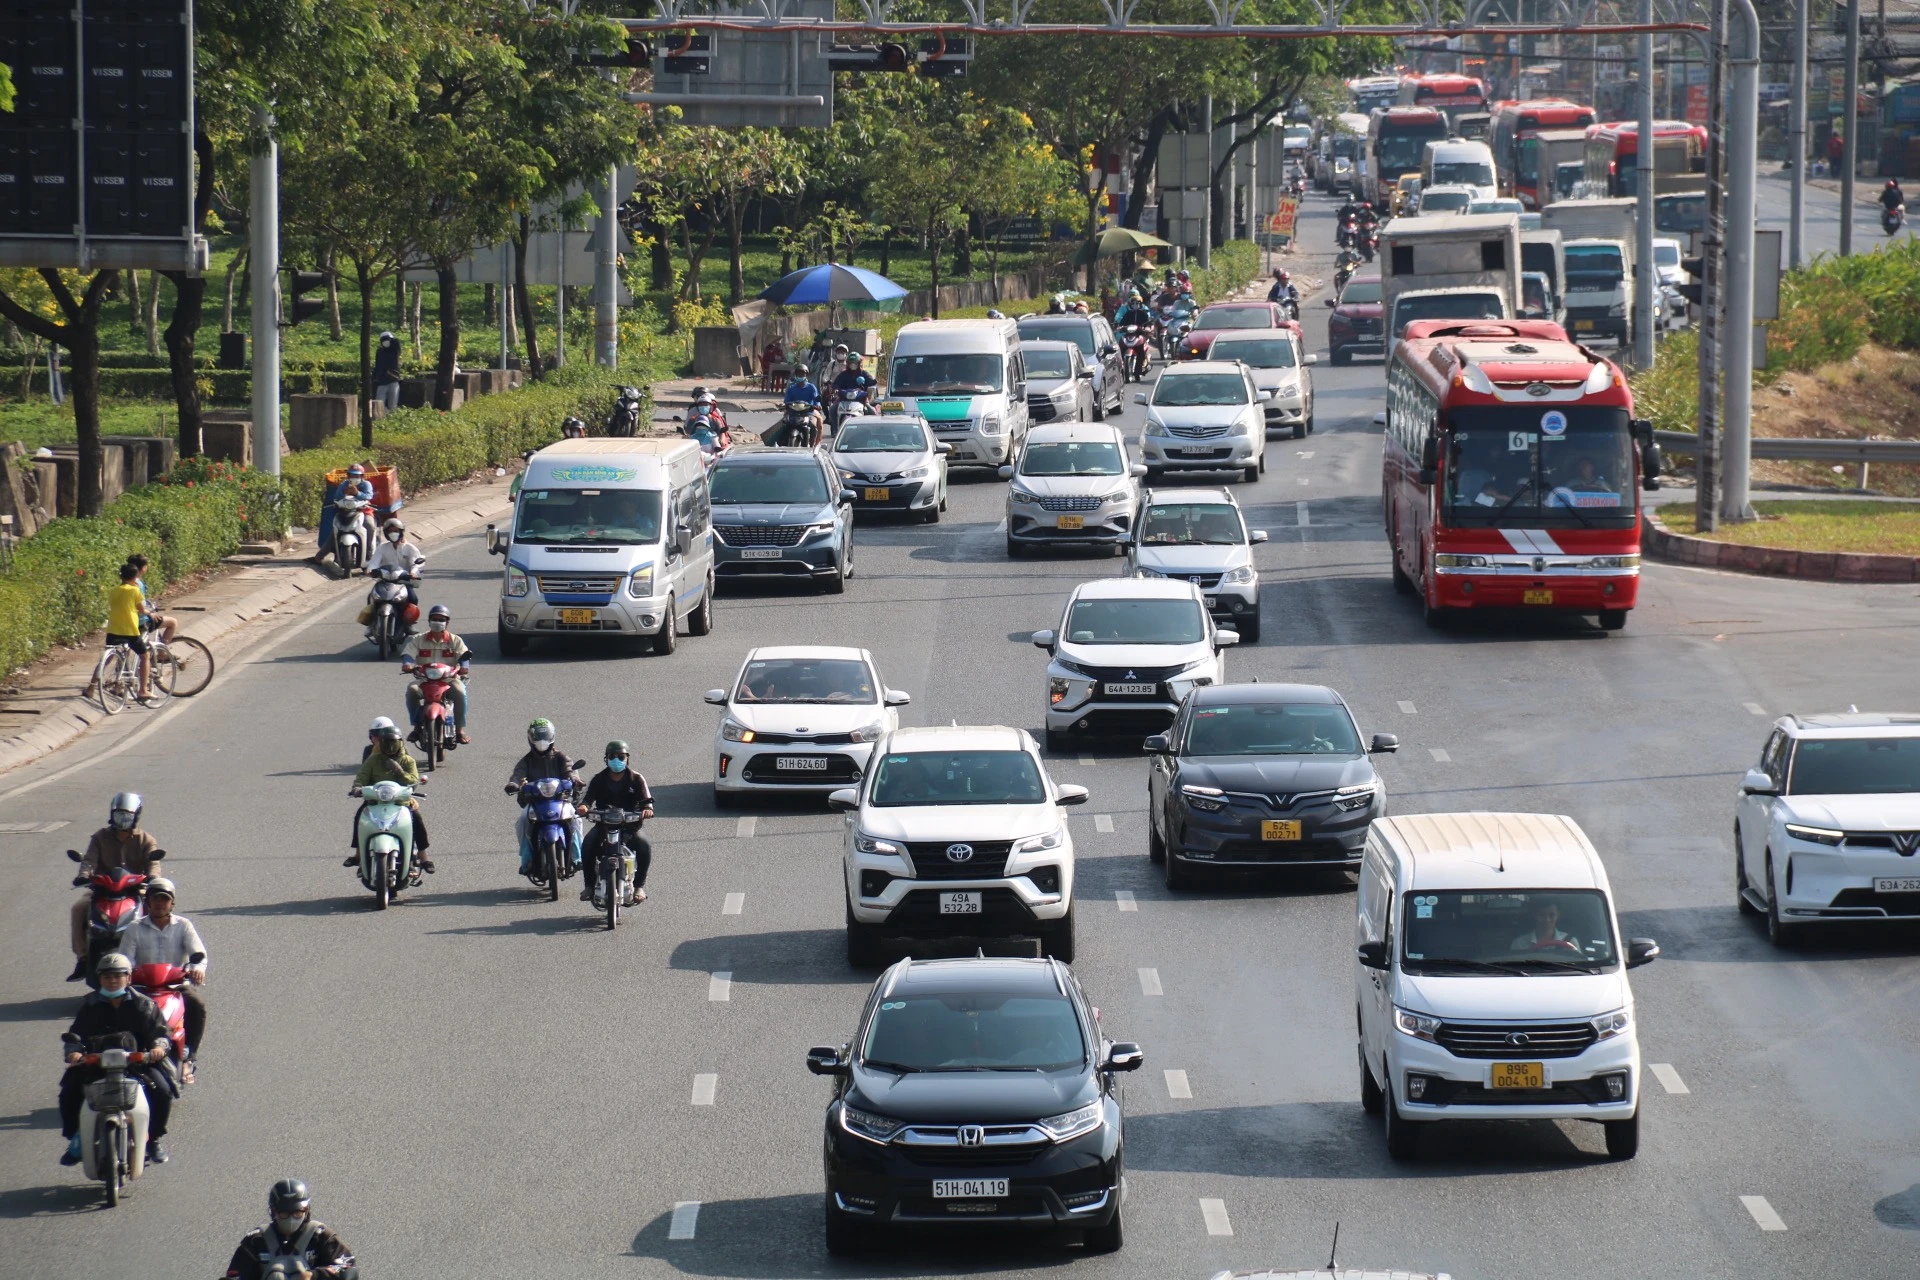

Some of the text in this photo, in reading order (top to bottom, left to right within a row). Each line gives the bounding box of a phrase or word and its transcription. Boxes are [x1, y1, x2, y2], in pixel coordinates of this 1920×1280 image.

[1513, 432, 1523, 448] 6
[1108, 685, 1152, 693] 64A-123.85
[778, 759, 826, 769] 51H-624.60
[1272, 821, 1290, 830] 62E
[1266, 830, 1296, 839] 002.71
[951, 893, 970, 903] 49A
[944, 903, 977, 913] 532.28
[1506, 1064, 1529, 1075] 89G
[1497, 1075, 1538, 1087] 004.10
[935, 1181, 1006, 1196] 51H-041.19
